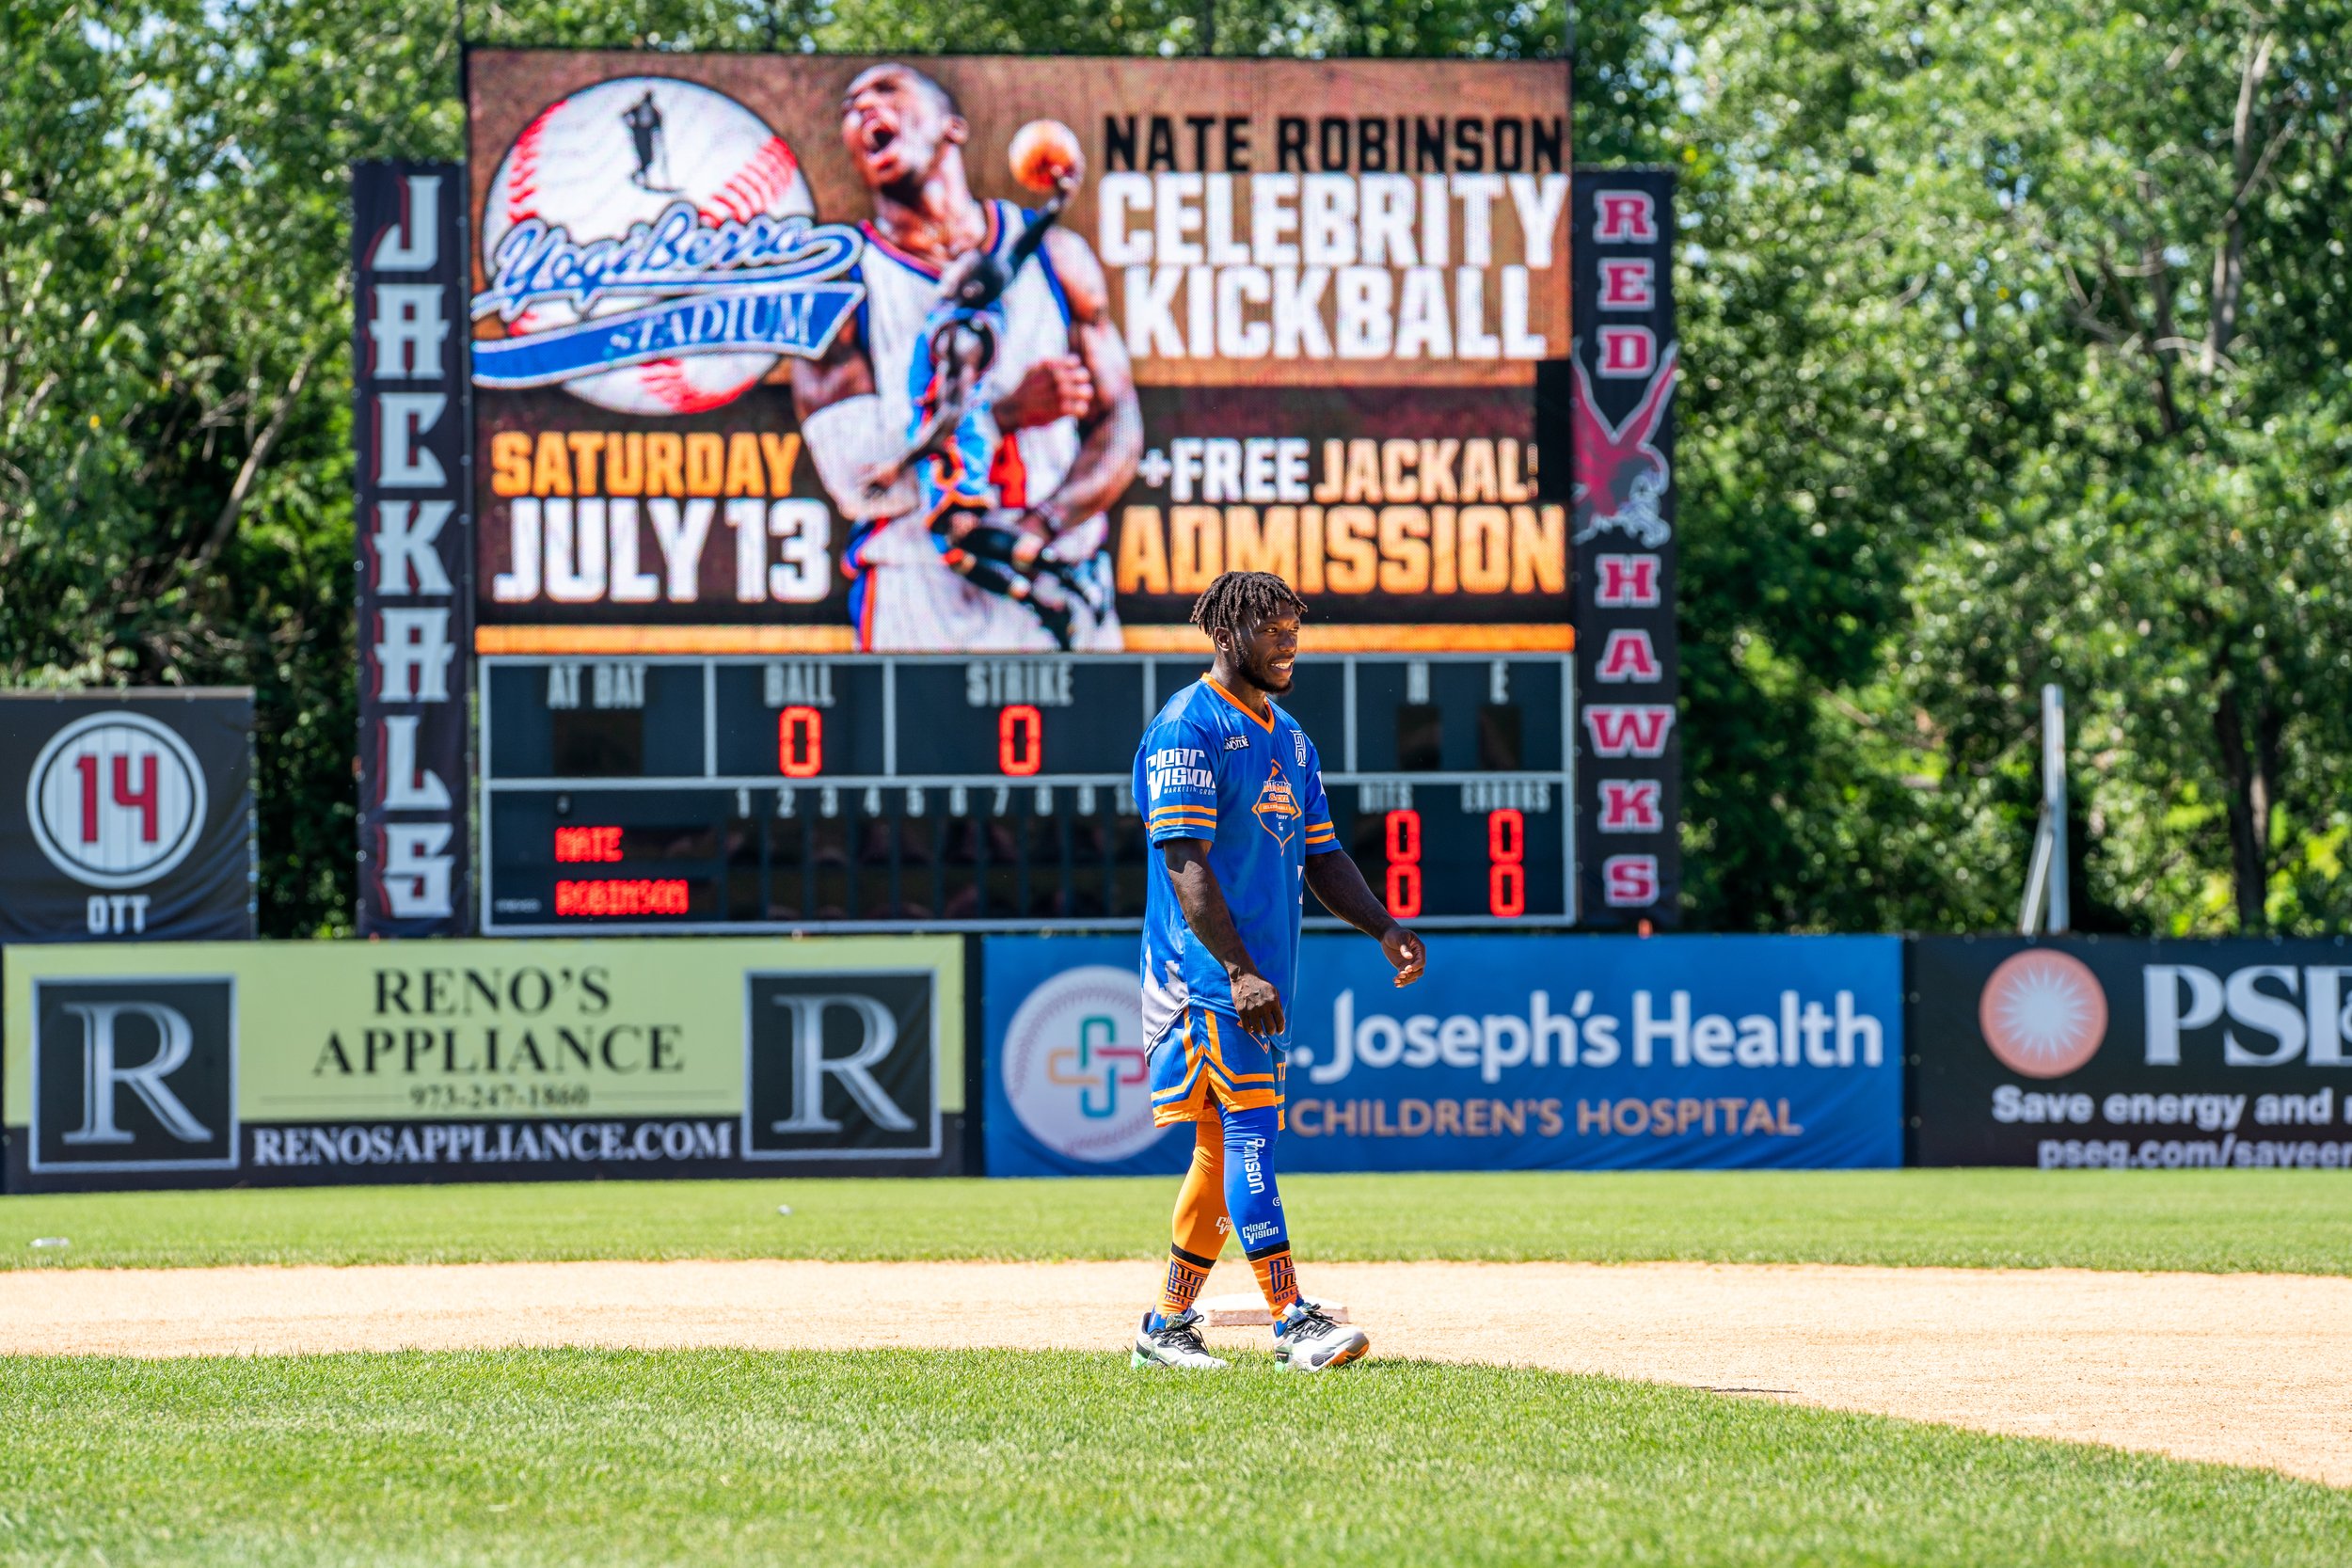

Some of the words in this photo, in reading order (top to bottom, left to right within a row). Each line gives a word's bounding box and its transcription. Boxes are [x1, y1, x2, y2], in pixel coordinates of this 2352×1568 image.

[1104, 115, 1251, 172] NATE
[1277, 115, 1565, 173] ROBINSON
[1099, 171, 1570, 268] CELEBRITY
[493, 218, 654, 322] Yogi
[1593, 190, 1658, 379] RED
[1123, 264, 1548, 361] KICKBALL
[491, 431, 802, 498] SATURDAY
[367, 174, 455, 919] JACKALS
[493, 497, 718, 604] JULY
[724, 498, 833, 603] 13
[1117, 504, 1566, 594] ADMISSION
[548, 662, 581, 708] AT
[764, 662, 835, 707] BALL
[966, 661, 1073, 706] STRIKE
[779, 705, 822, 778] 0
[999, 705, 1041, 777] 0
[1582, 553, 1676, 907] HAWKS
[76, 753, 158, 843] 14
[735, 786, 751, 818] 1
[777, 786, 795, 818] 2
[864, 786, 882, 818] 4
[992, 785, 1009, 817] 7
[555, 826, 624, 863] NATE
[1386, 809, 1421, 863] 0
[1489, 808, 1524, 863] 0
[87, 895, 151, 933] OTT
[1386, 863, 1422, 918] 0
[1490, 863, 1525, 918] 0
[373, 966, 612, 1017] RENO'S
[312, 1023, 685, 1077] APPLIANCE
[771, 992, 917, 1132] R
[1309, 988, 1621, 1085] Joseph's
[1633, 989, 1883, 1069] Health
[62, 1000, 214, 1144] R
[409, 1085, 590, 1110] 973-247-1860
[1289, 1097, 1564, 1137] CHILDREN'S
[1578, 1097, 1804, 1137] HOSPITAL
[1992, 1085, 2095, 1124] Save
[2102, 1093, 2247, 1131] energy
[2254, 1087, 2333, 1124] and
[254, 1120, 733, 1166] RENOSAPPLIANCE.COM
